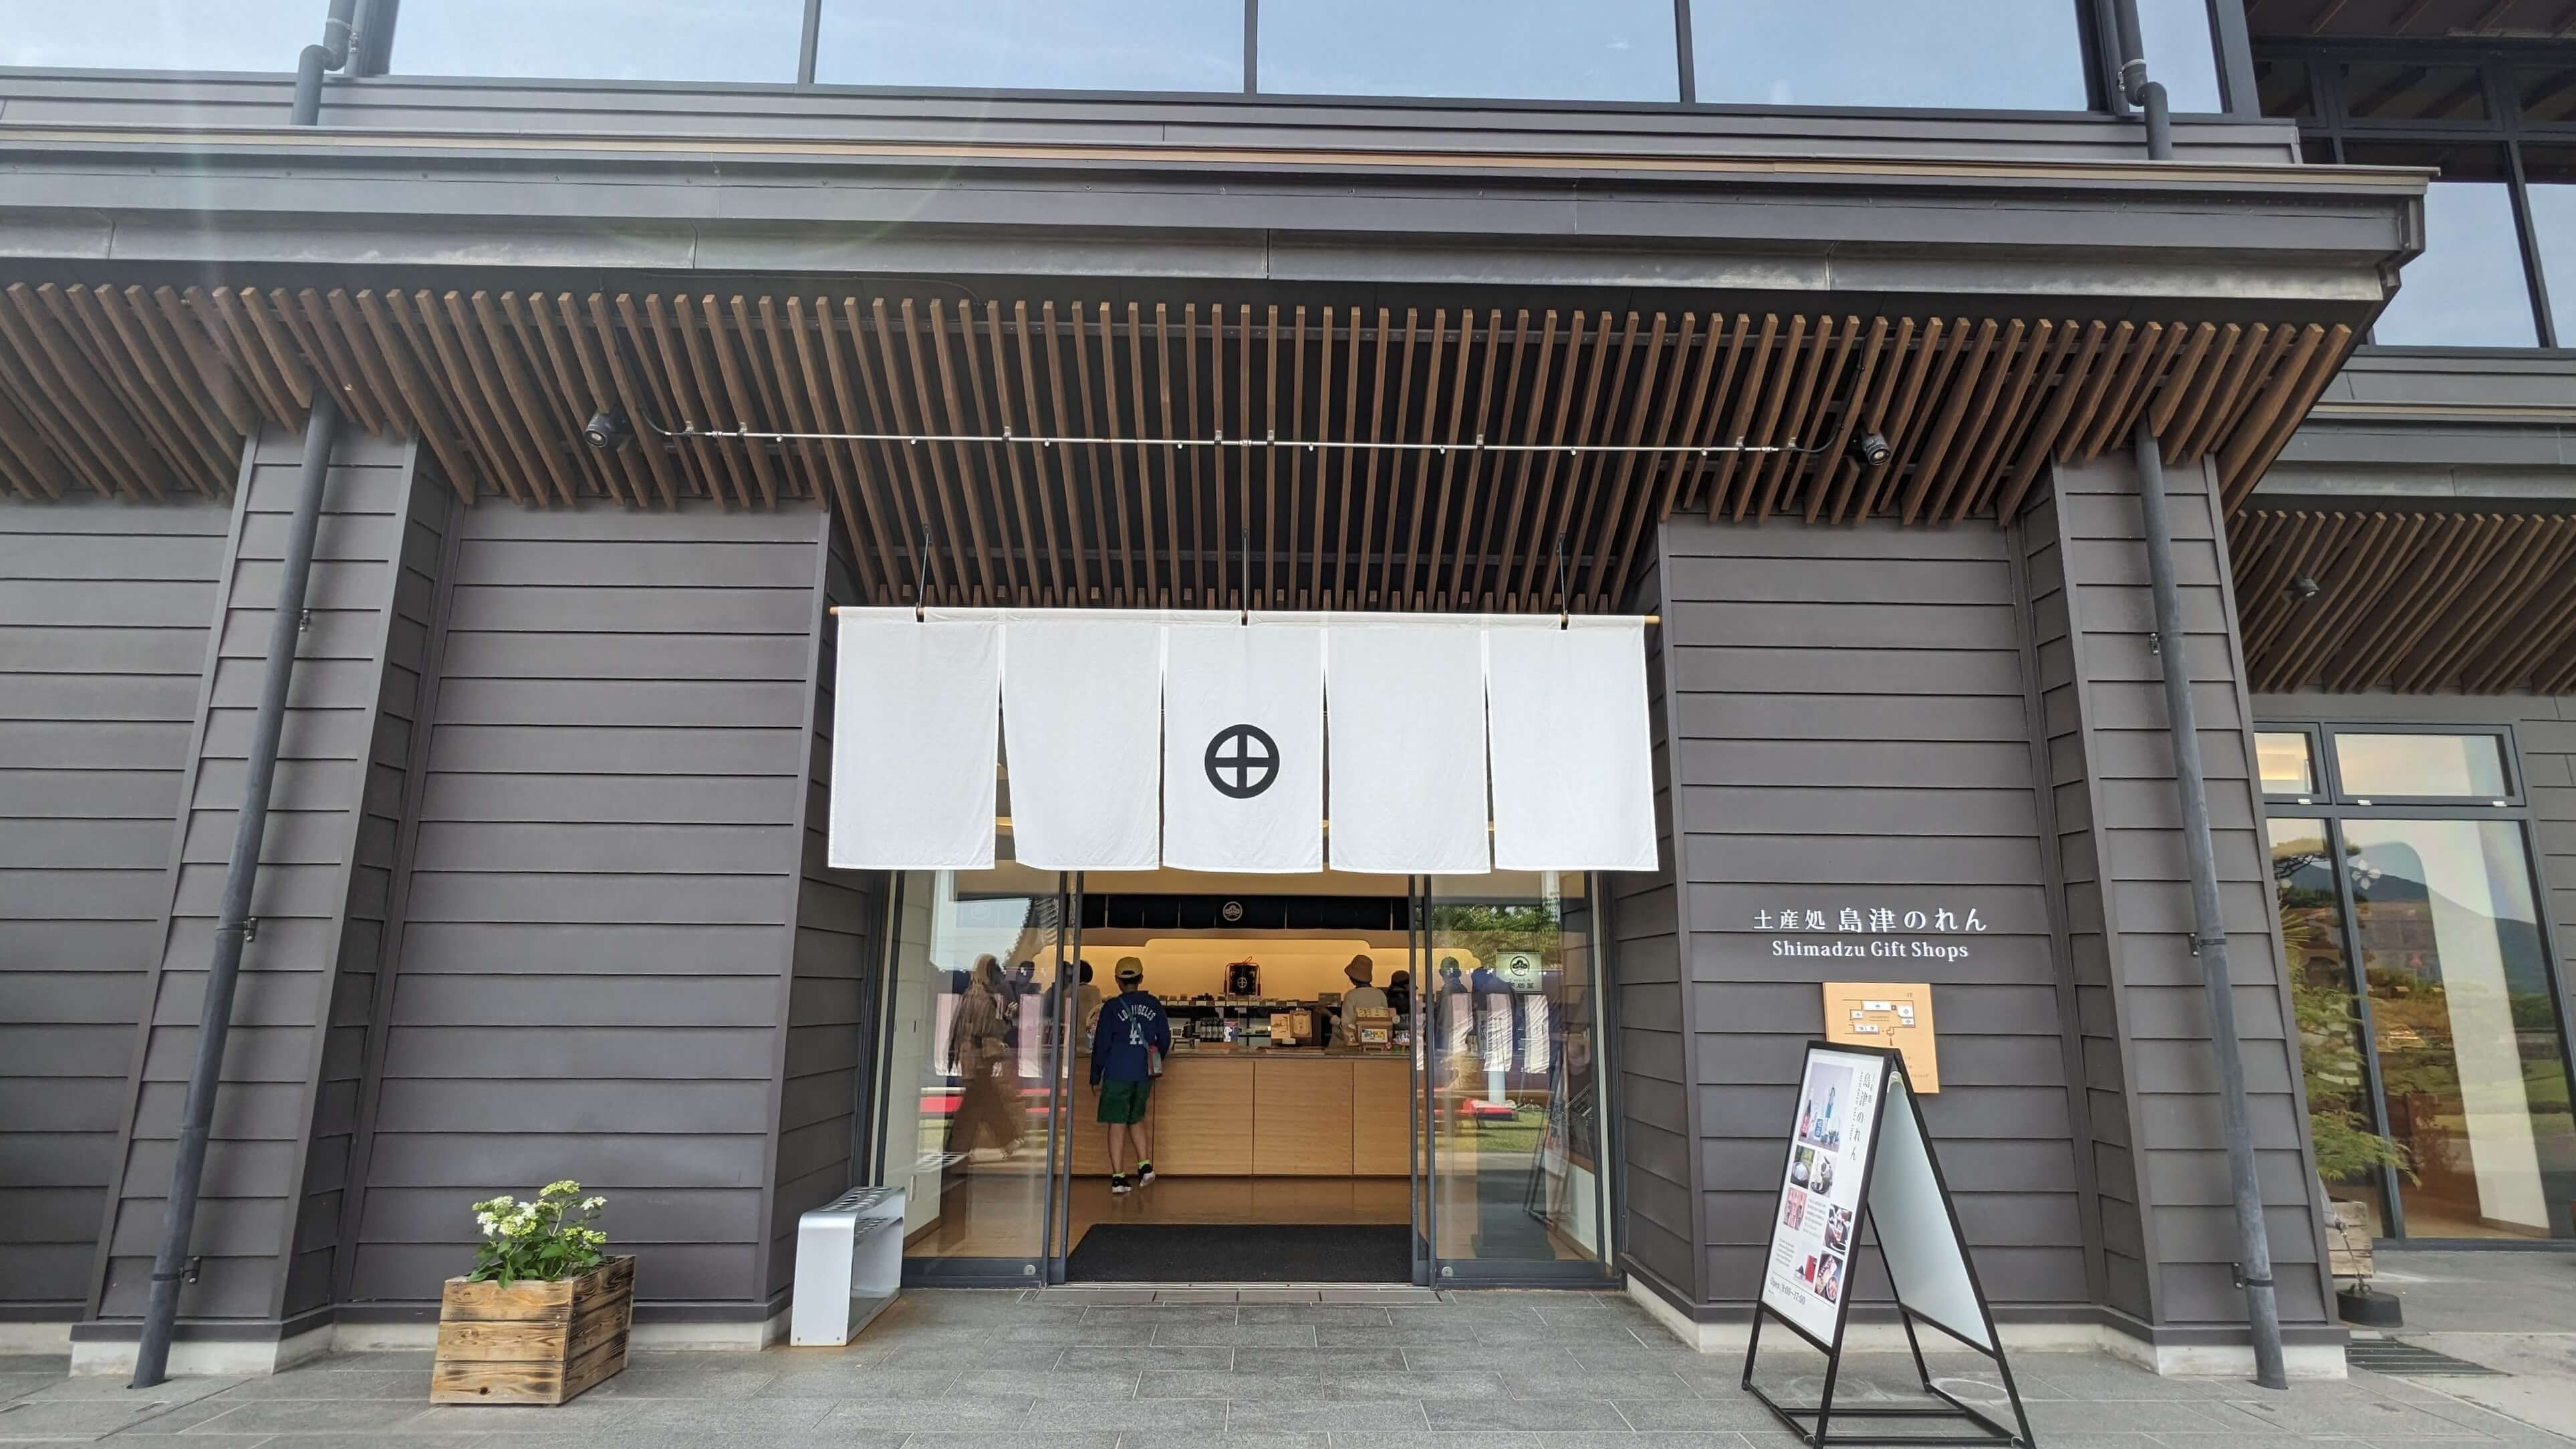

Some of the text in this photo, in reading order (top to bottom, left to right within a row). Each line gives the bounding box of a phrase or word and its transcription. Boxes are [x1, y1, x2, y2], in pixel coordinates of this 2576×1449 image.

[1753, 907, 1987, 934] 土産処 島津のれん
[1772, 940, 1968, 962] Shimadzu Gift Shops
